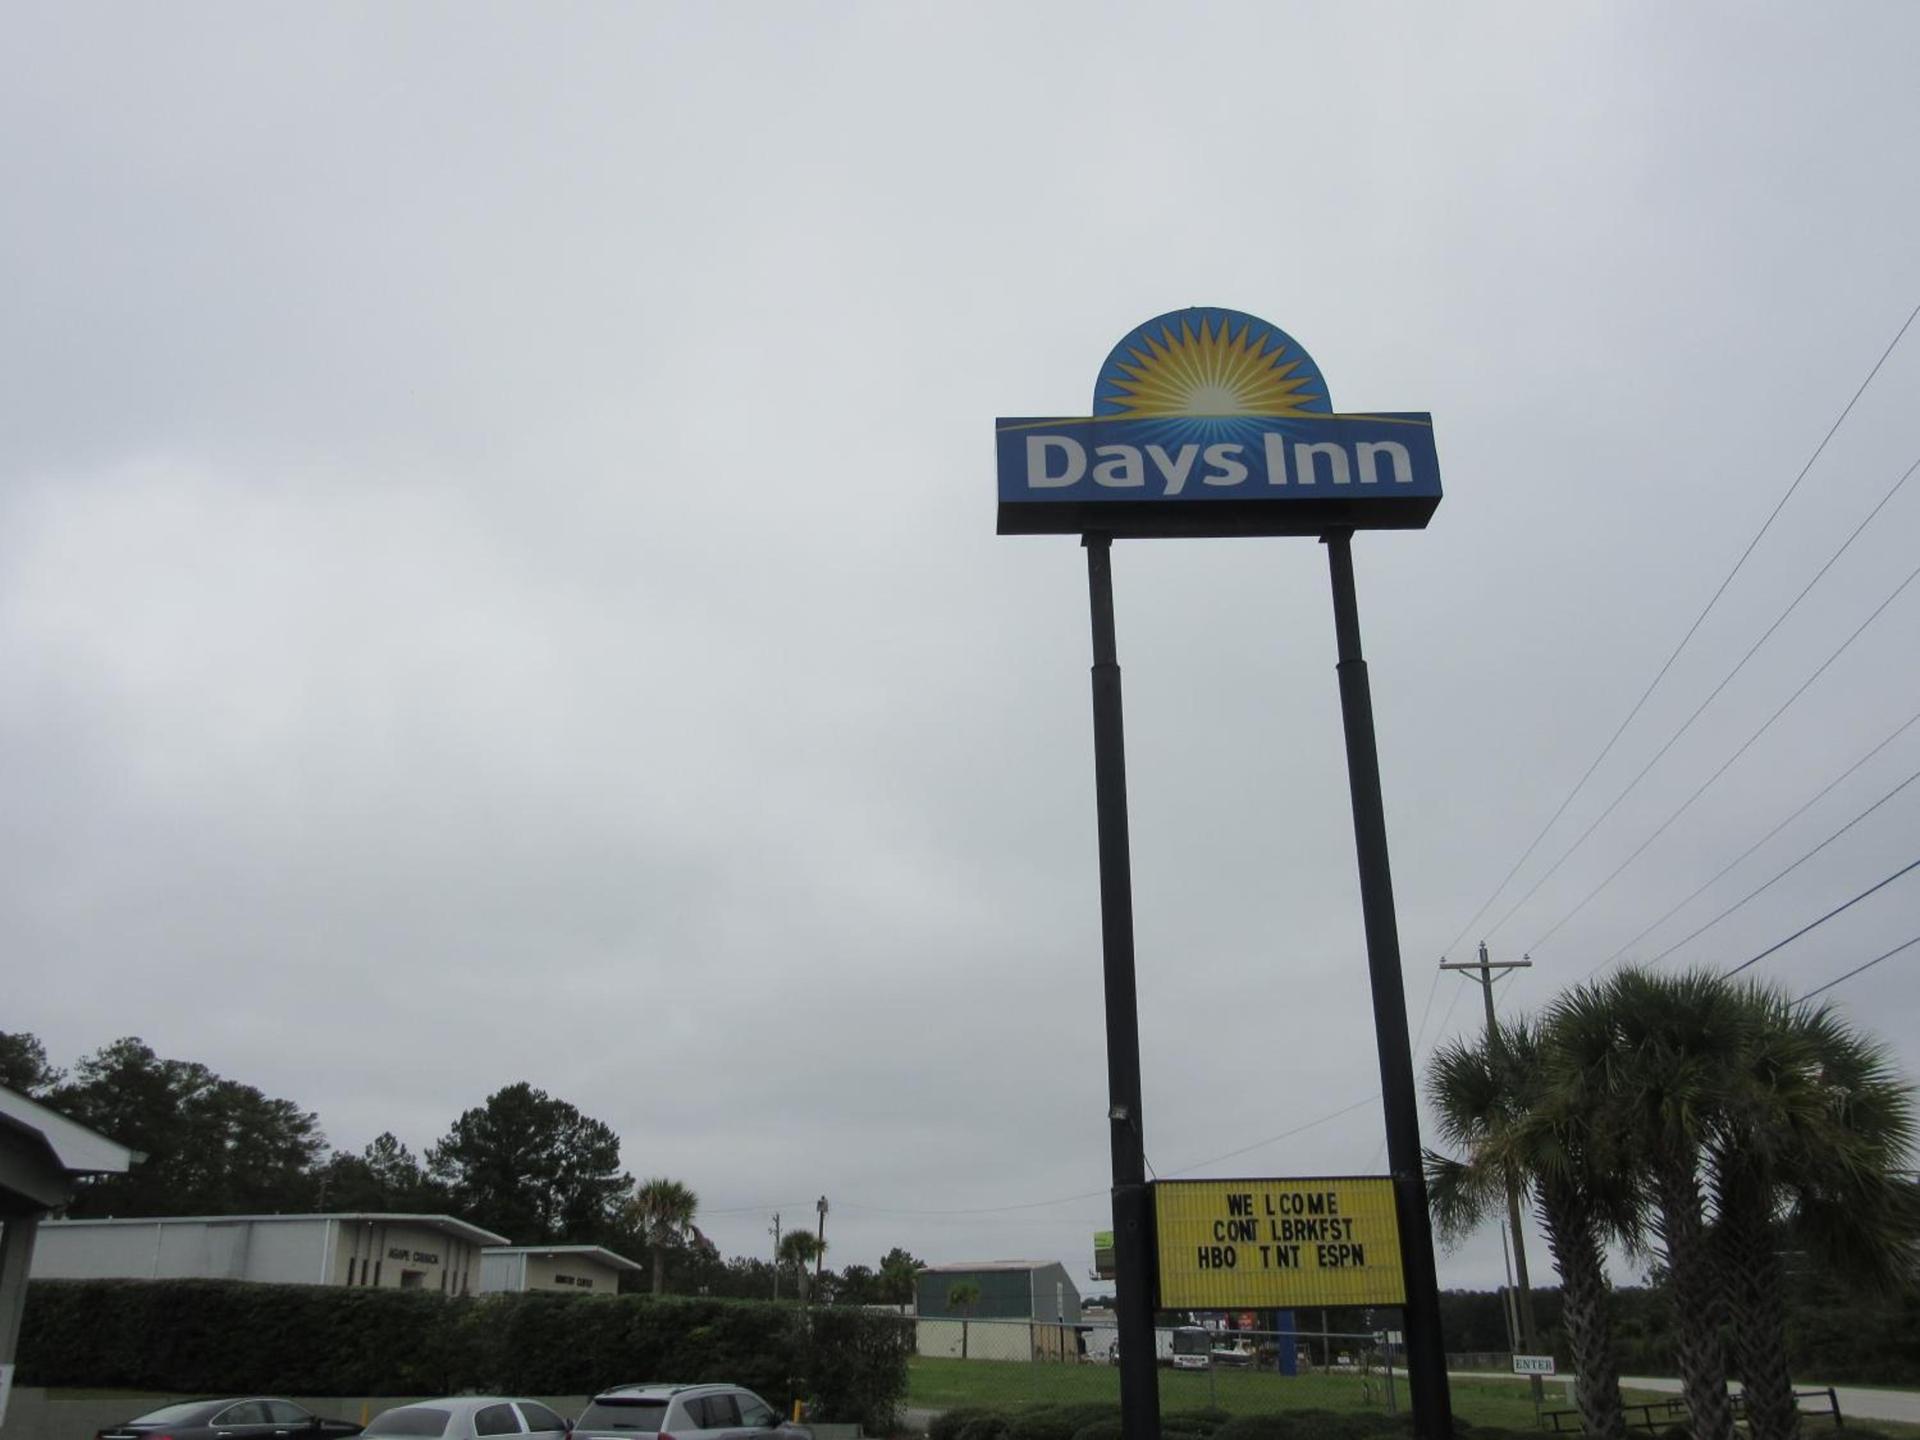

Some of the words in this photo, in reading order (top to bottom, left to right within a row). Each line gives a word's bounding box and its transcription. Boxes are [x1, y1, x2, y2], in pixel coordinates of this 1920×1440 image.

[1027, 436, 1246, 495] Days
[1264, 433, 1413, 485] Inn
[1198, 1246, 1236, 1269] HBO
[1260, 1246, 1300, 1268] TNT
[1318, 1244, 1364, 1267] ESPN
[1515, 1359, 1552, 1371] ENTER
